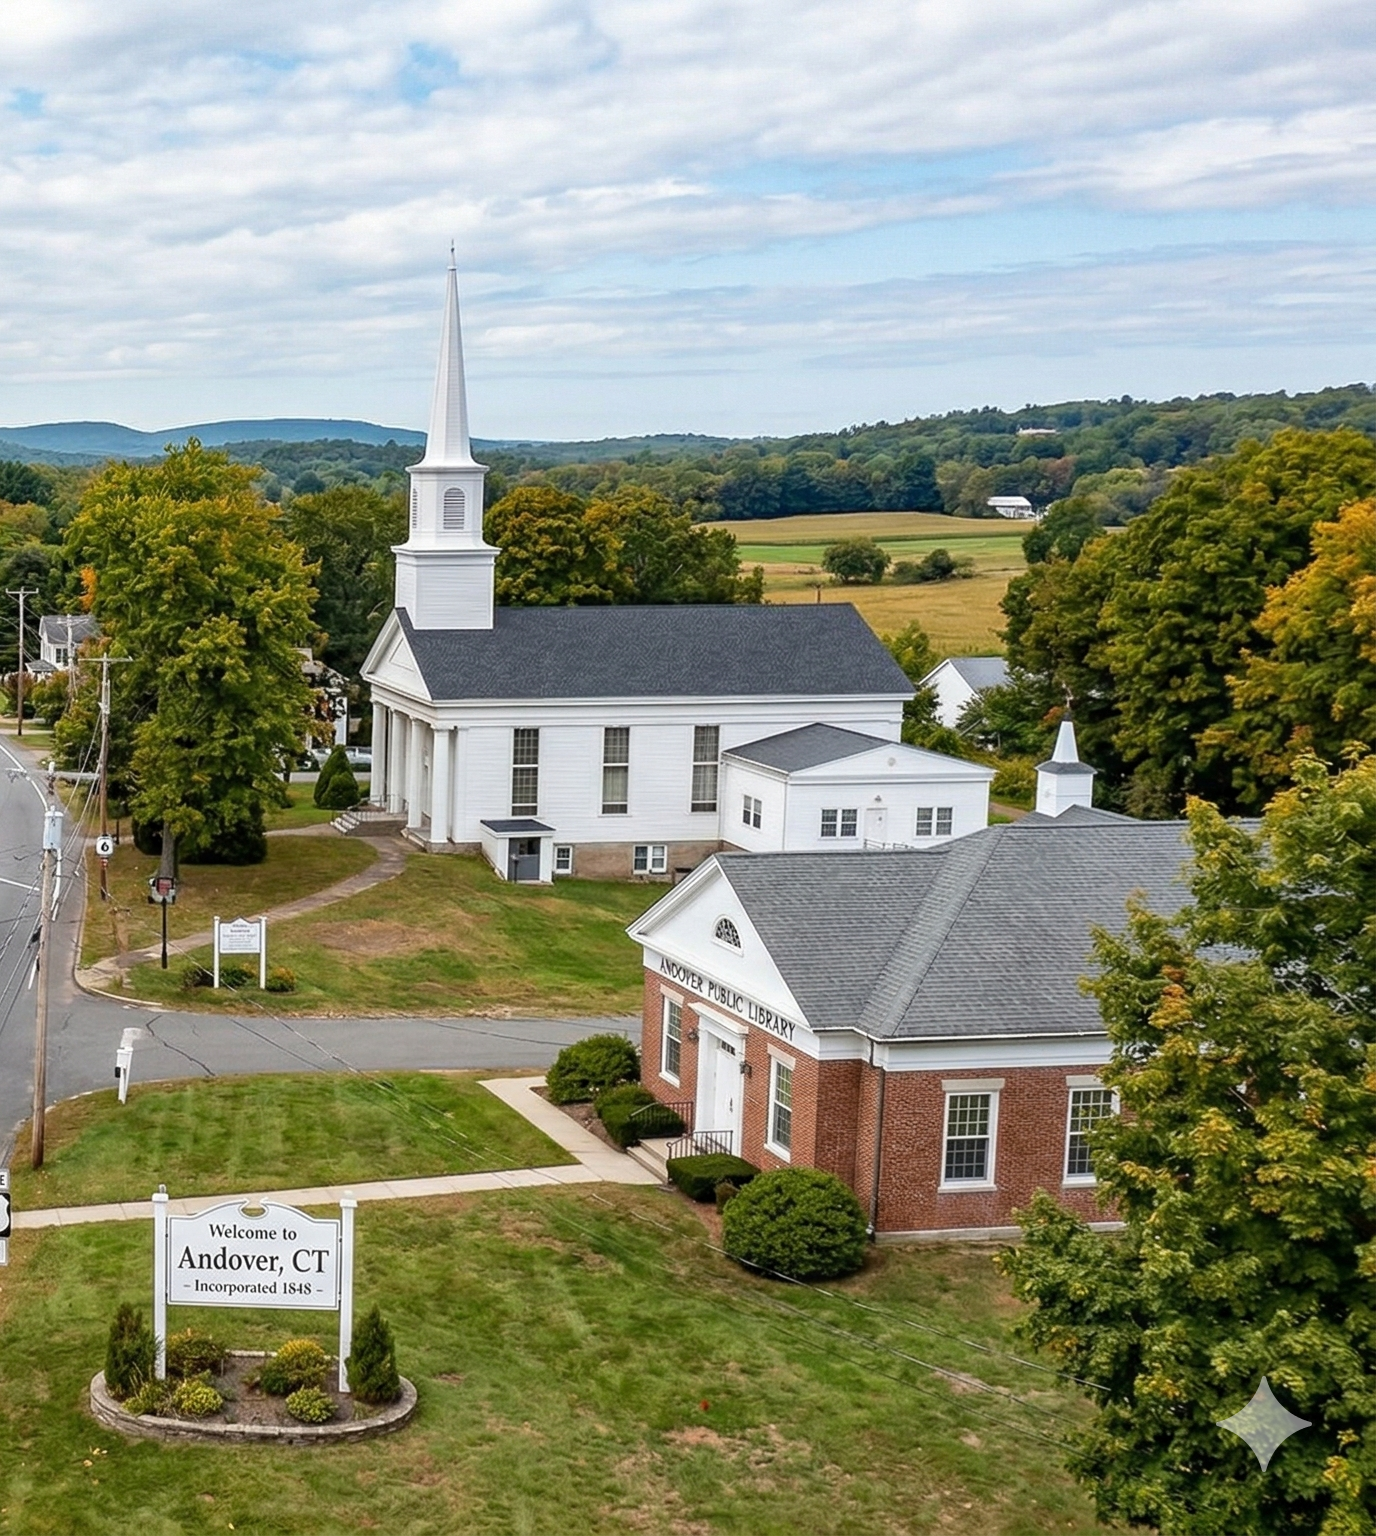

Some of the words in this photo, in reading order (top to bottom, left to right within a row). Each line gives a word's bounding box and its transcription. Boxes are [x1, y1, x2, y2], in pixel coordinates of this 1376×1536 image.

[101, 842, 109, 852] 6
[708, 981, 744, 1013] PUBLIC
[748, 1002, 796, 1041] LIBRARY
[209, 1223, 277, 1240] Welcome
[283, 1227, 297, 1241] to
[177, 1246, 284, 1277] Andover,
[292, 1249, 330, 1273] CT
[195, 1279, 277, 1296] Incorporated
[282, 1282, 312, 1295] 1848
